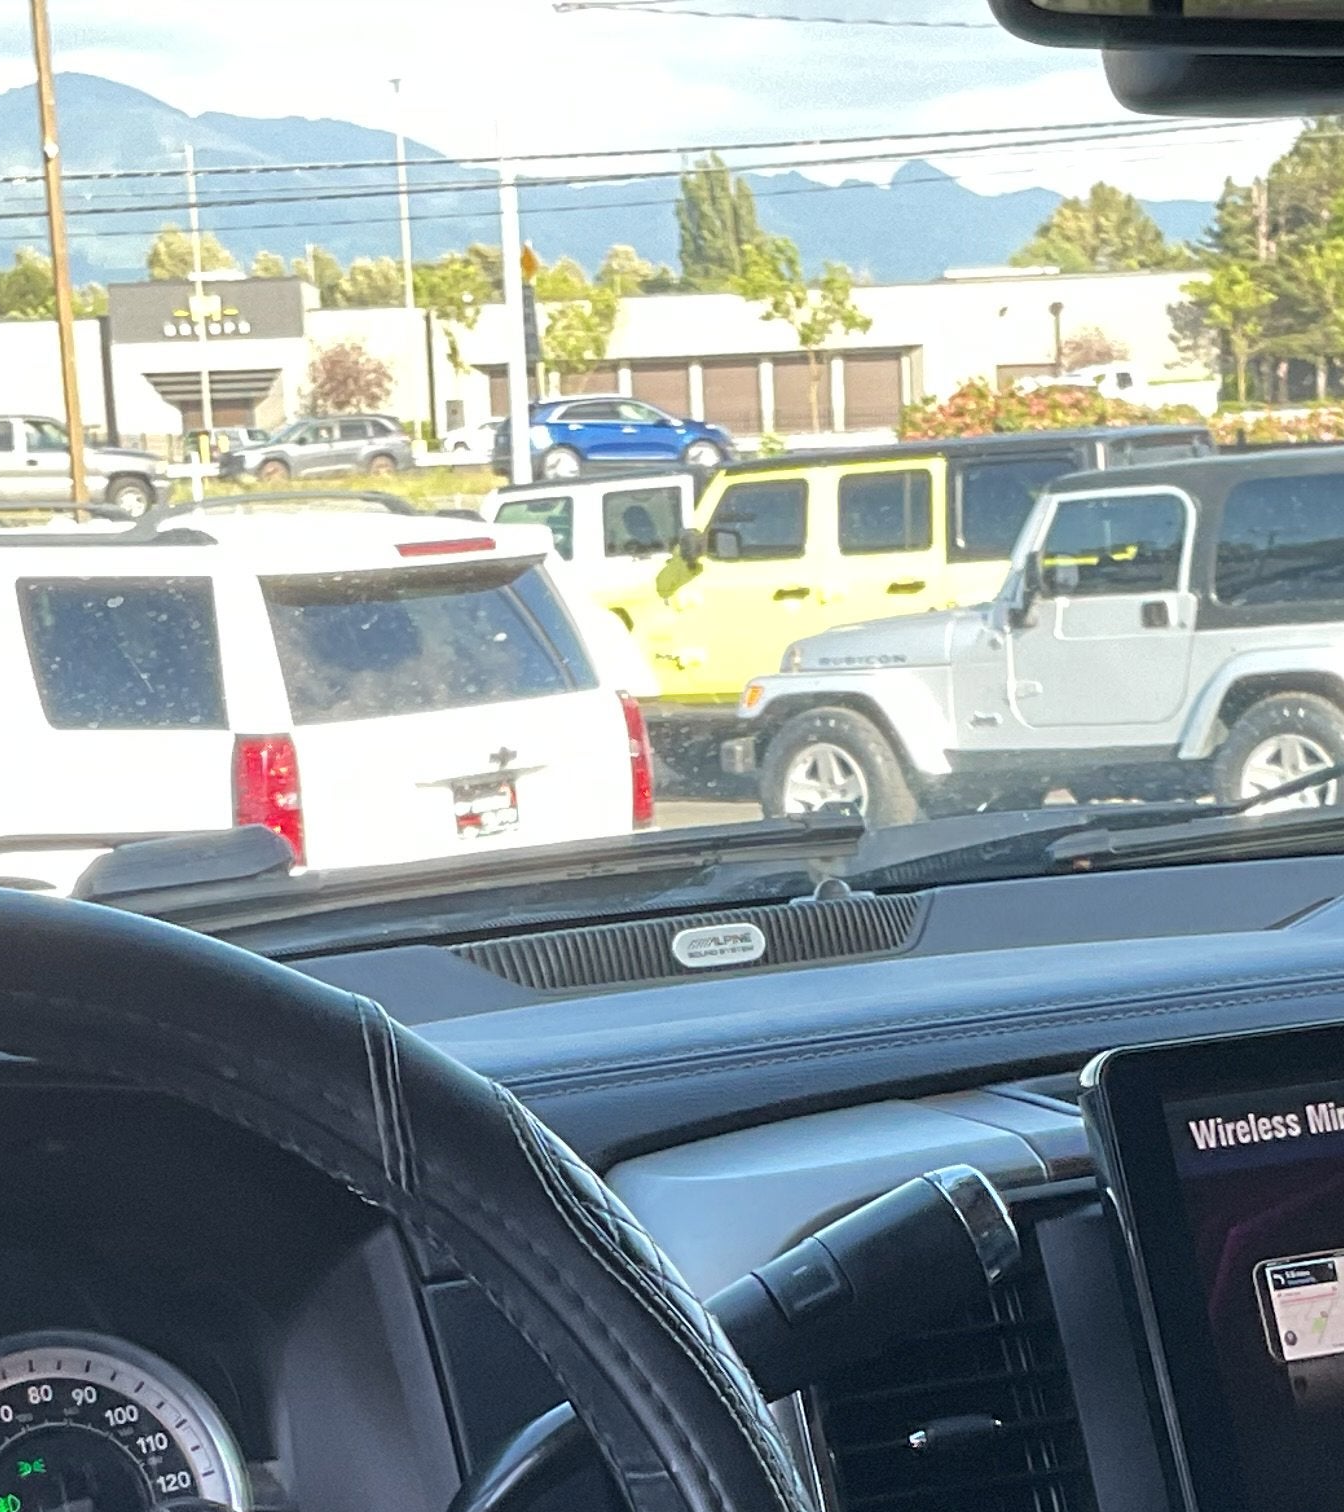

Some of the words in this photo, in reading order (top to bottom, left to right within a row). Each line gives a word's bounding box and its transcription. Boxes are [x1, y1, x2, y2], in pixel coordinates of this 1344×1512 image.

[819, 654, 907, 666] RUBICON
[1189, 1112, 1302, 1151] Wireless
[27, 1384, 53, 1405] 80
[71, 1385, 97, 1406] 90
[105, 1404, 139, 1427] 100
[136, 1432, 168, 1455] 110
[157, 1471, 191, 1493] 120
